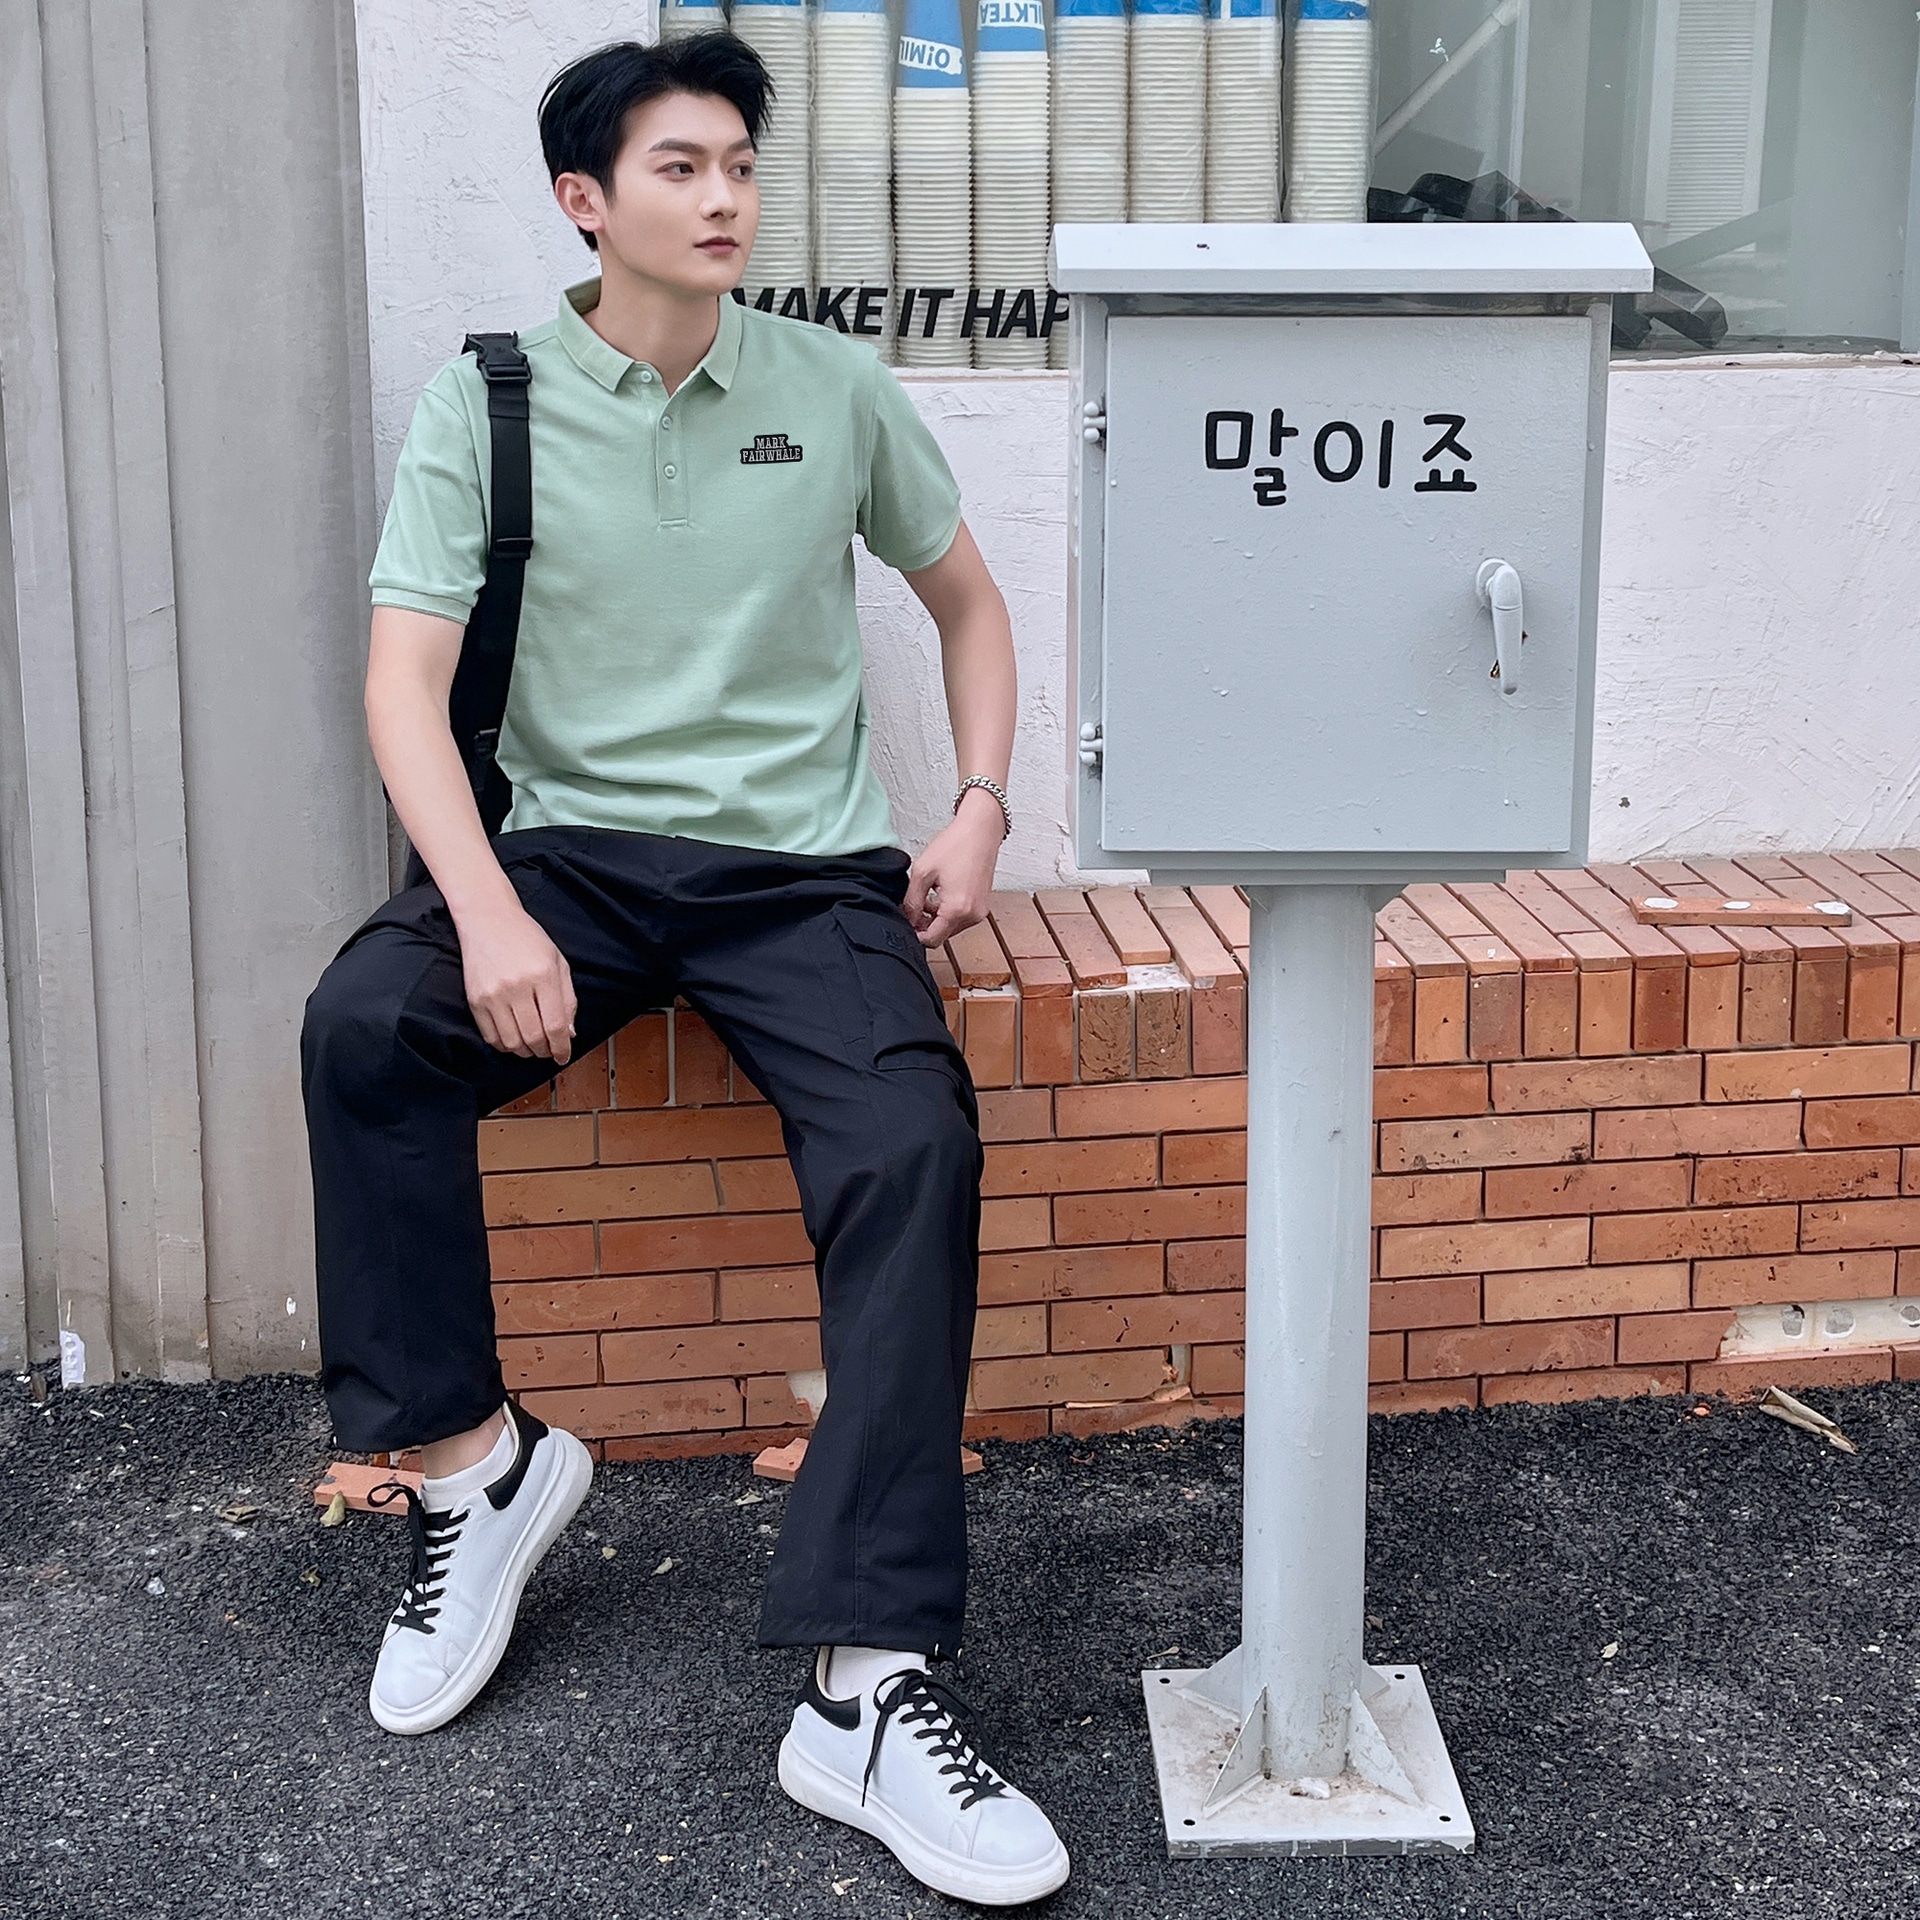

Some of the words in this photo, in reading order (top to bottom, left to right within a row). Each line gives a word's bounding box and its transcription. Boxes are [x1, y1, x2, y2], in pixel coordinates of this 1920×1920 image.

[897, 288, 955, 338] IT
[960, 288, 1070, 338] HAP
[742, 448, 801, 462] FAIRWHALE
[756, 436, 786, 450] MARK
[1205, 408, 1478, 506] 말이죠
